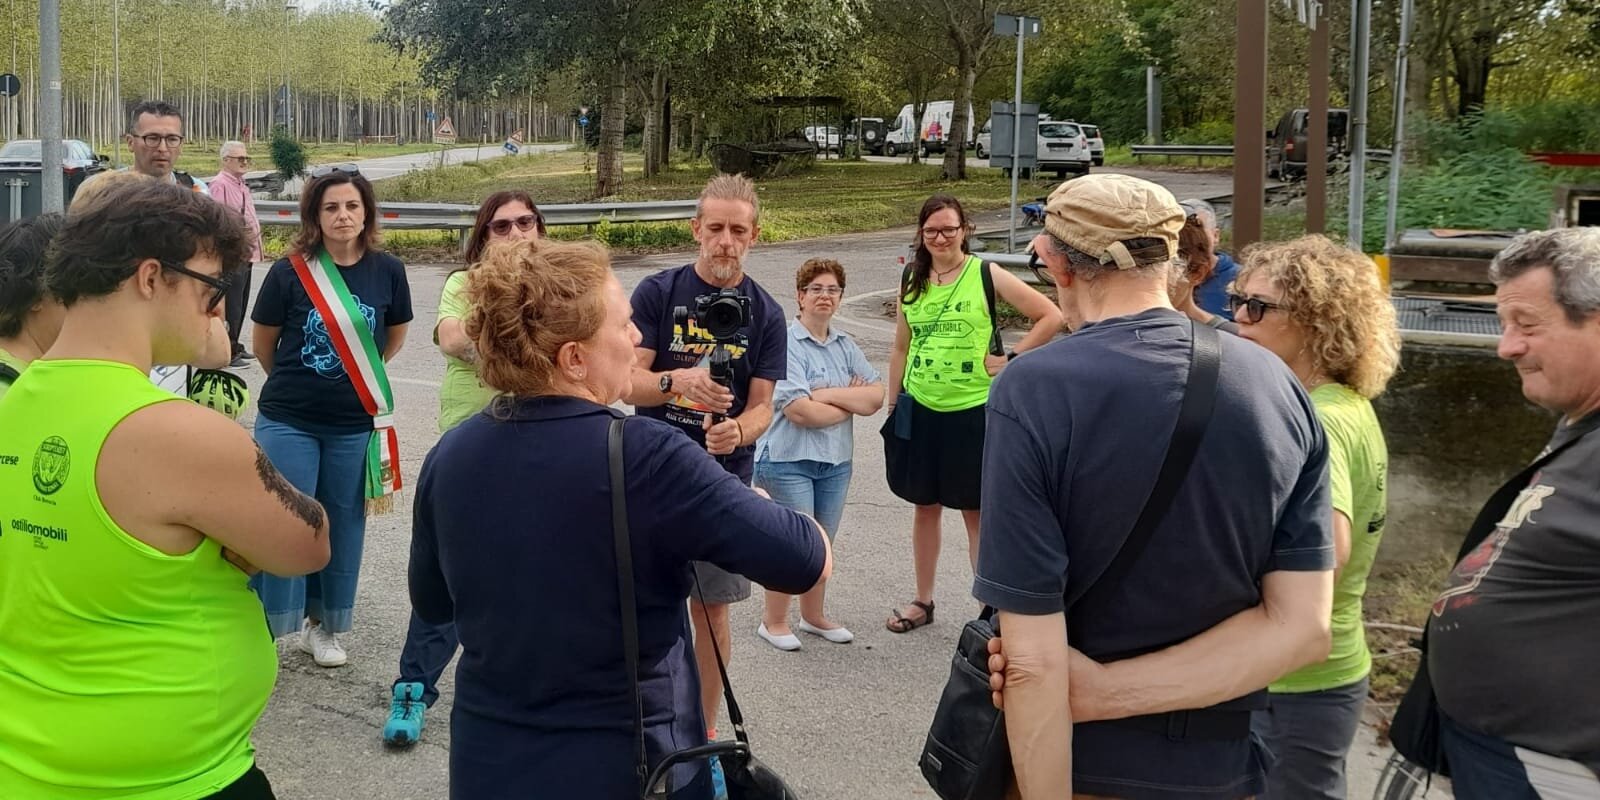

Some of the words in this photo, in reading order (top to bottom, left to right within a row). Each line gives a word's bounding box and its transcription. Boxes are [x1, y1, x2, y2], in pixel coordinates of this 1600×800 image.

[684, 343, 747, 360] FUTRE
[678, 416, 704, 426] CAPACIT
[11, 518, 68, 542] ostiliomobili
